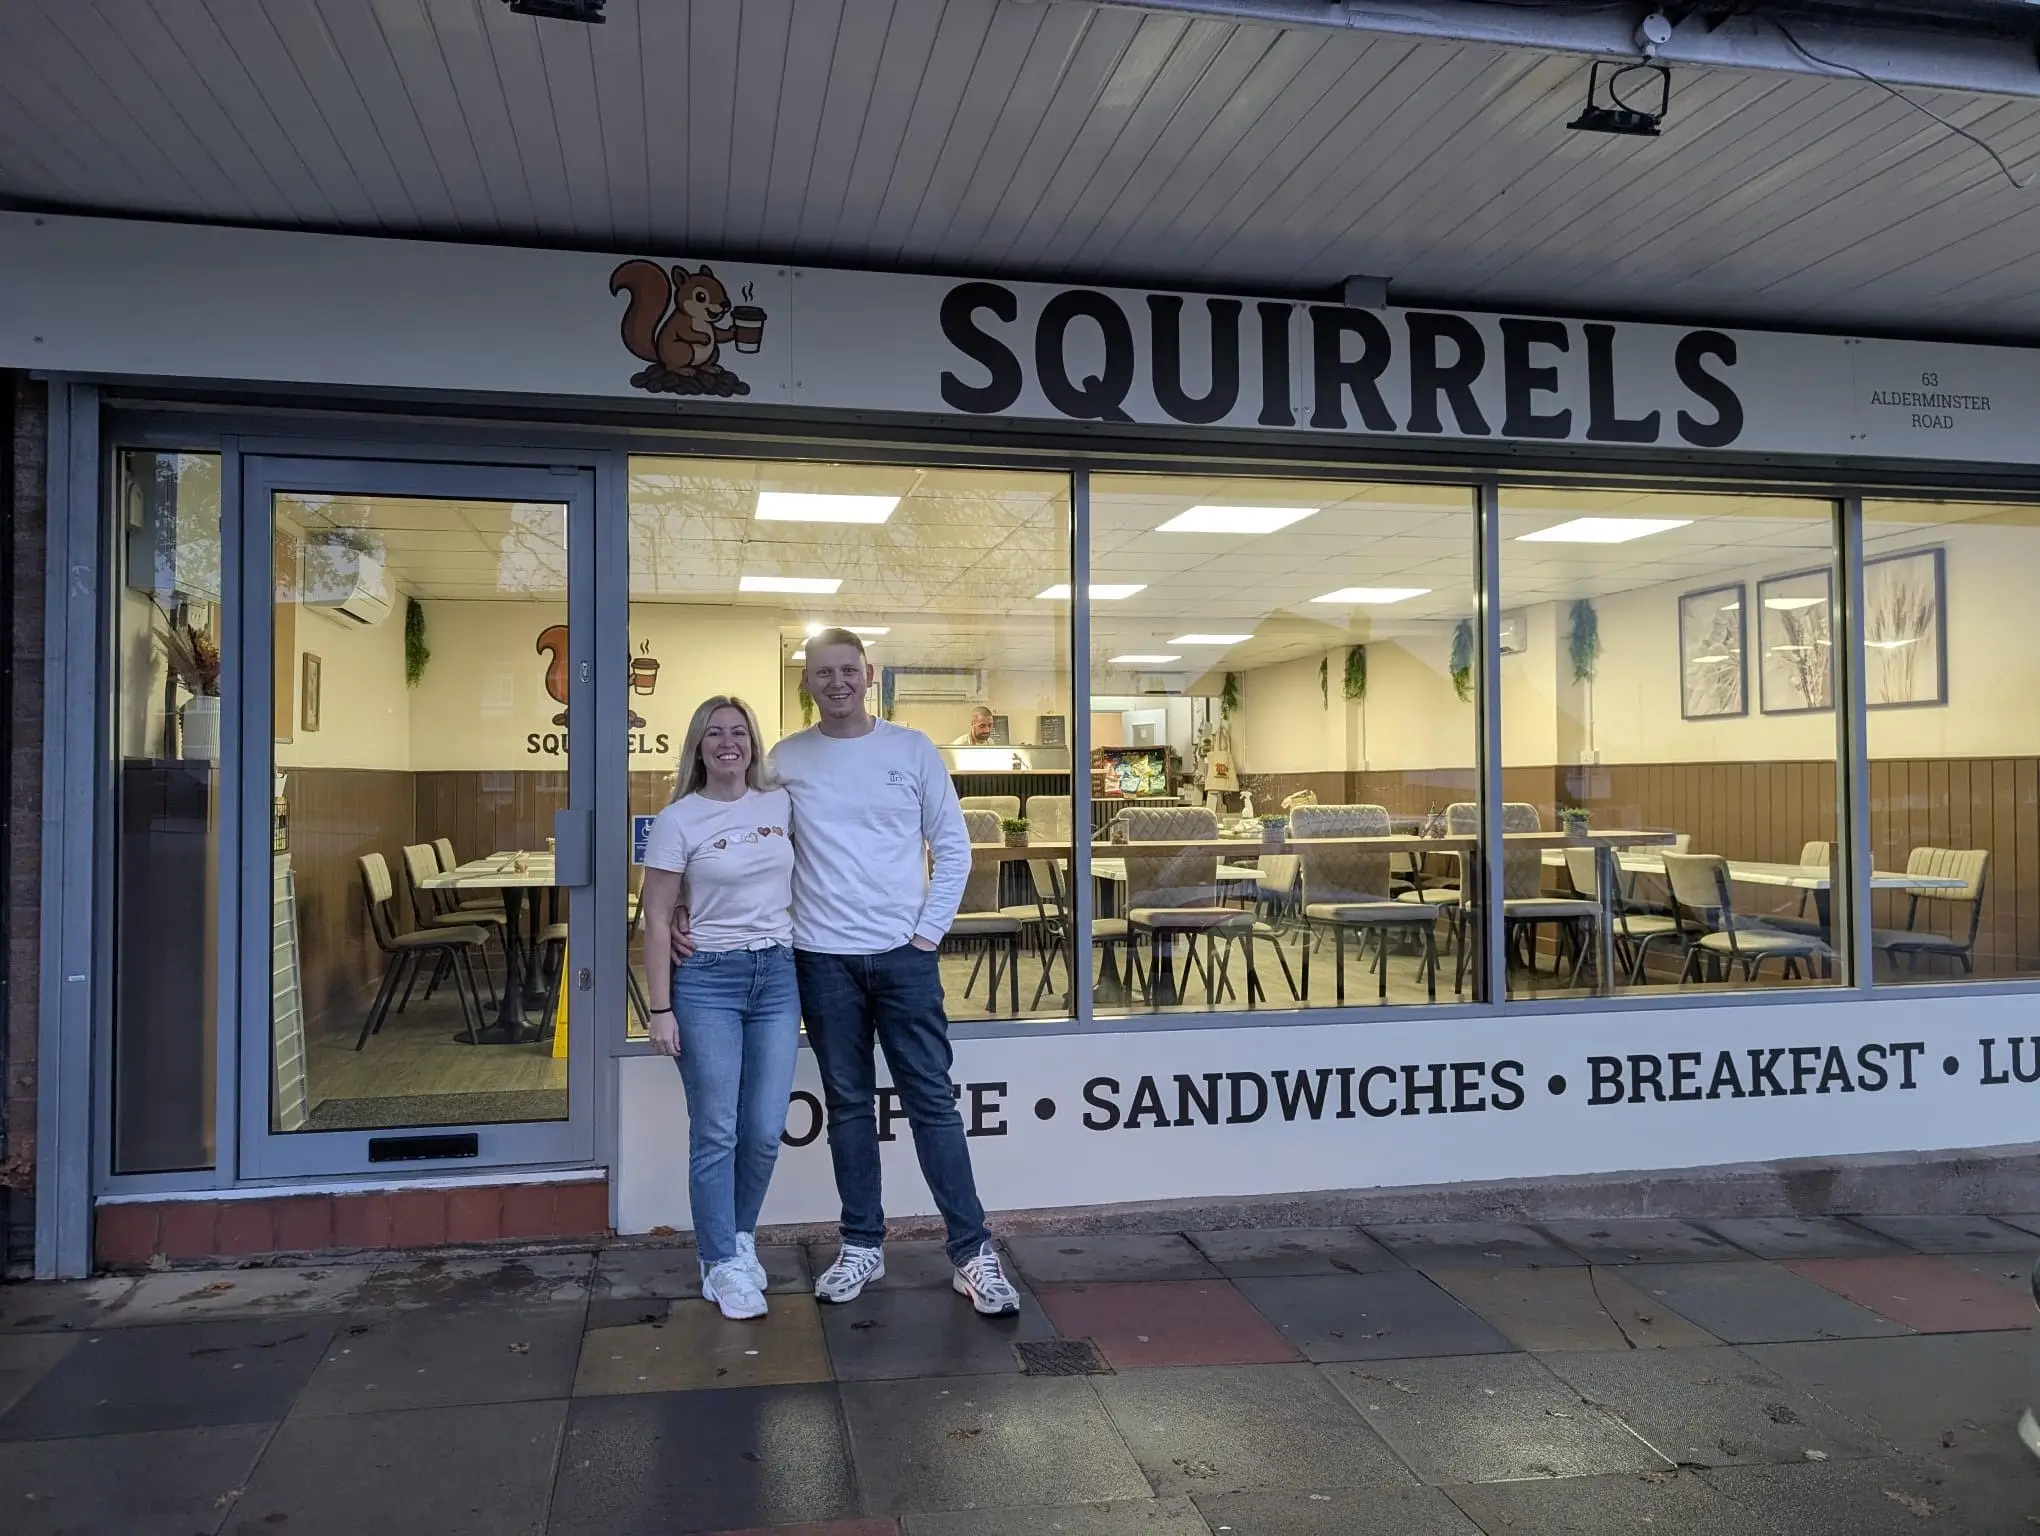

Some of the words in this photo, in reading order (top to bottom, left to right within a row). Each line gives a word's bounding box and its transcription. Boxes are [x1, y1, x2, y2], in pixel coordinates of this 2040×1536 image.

[939, 281, 1744, 448] SQUIRRELS
[1922, 372, 1938, 387] 63
[1871, 390, 1991, 411] ALDERMINSTER
[1911, 413, 1954, 429] ROAD
[527, 733, 669, 755] SQELS
[780, 1082, 1008, 1147] OFE
[1082, 1059, 1525, 1131] SANDWICHES
[1586, 1041, 1925, 1106] BREAKFAST
